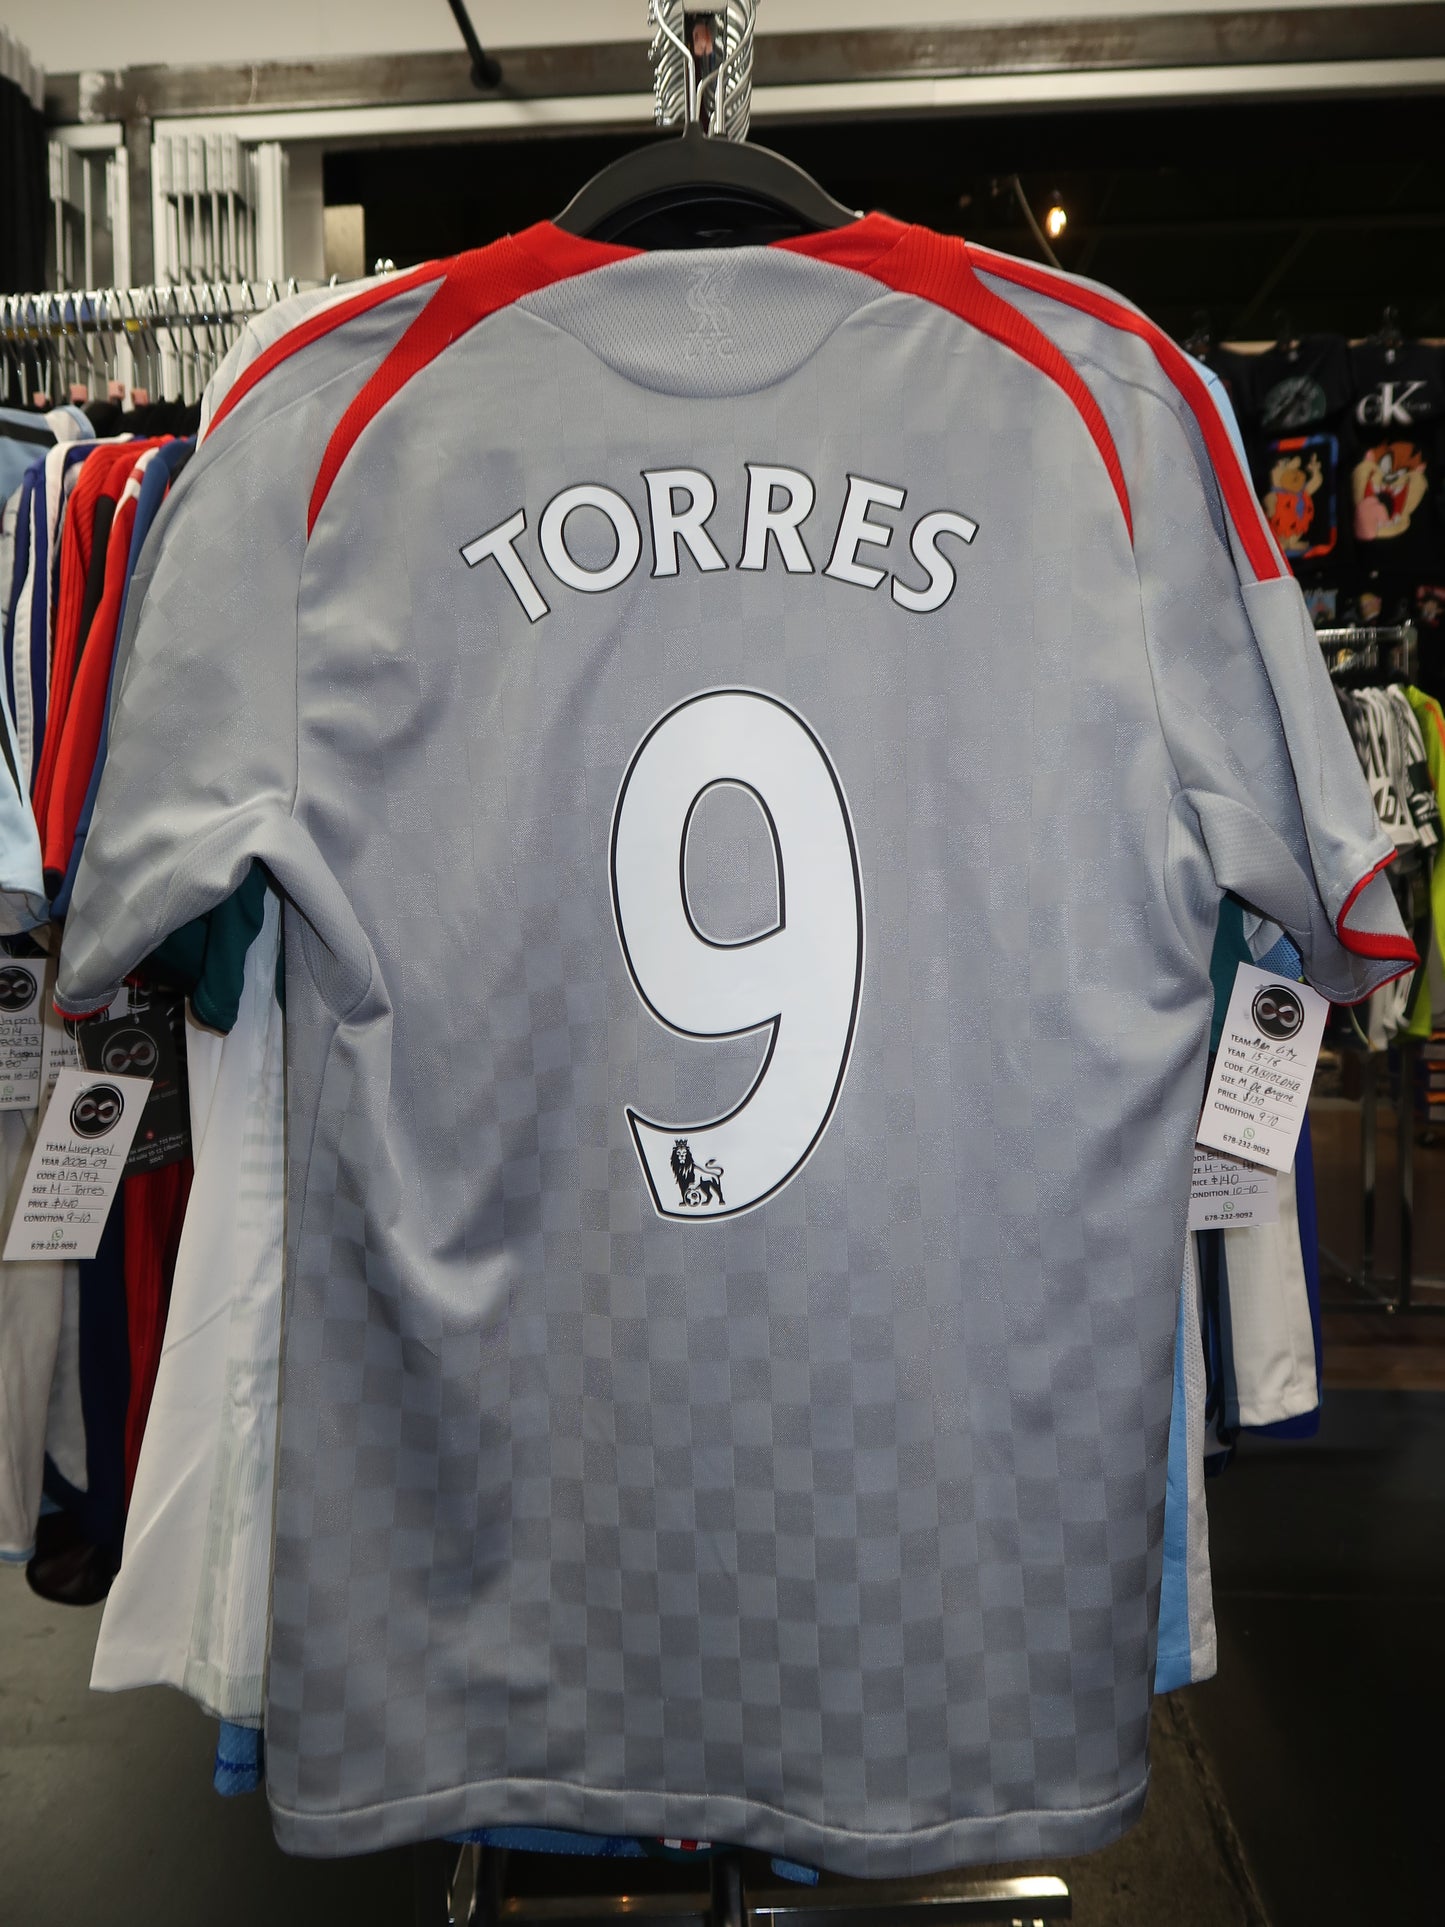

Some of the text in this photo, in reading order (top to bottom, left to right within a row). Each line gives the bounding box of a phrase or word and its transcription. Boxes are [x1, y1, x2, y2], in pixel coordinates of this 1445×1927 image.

[460, 462, 980, 624] TORRES
[608, 684, 866, 1224] 9
[1231, 1034, 1252, 1047] TEAM
[1227, 1047, 1246, 1059] YEAR
[1223, 1061, 1244, 1073] CODE
[1220, 1074, 1236, 1085] SIZE
[1238, 1077, 1248, 1087] M
[1249, 1082, 1262, 1093] De
[1216, 1087, 1265, 1106] PRICE $130
[1213, 1101, 1255, 1121] CONDITION
[46, 1143, 66, 1152] TEAM
[68, 1139, 114, 1158] Liverpool
[1222, 1134, 1271, 1156] 678-232-9092
[41, 1157, 60, 1166] YEAR
[36, 1171, 57, 1180] CODE
[1211, 1173, 1240, 1187] $140
[32, 1186, 47, 1194] SIZE
[71, 1184, 104, 1196] Torres
[1232, 1184, 1259, 1196] 10-10
[28, 1200, 49, 1209] PRICE
[23, 1213, 64, 1223] CONDITION
[1204, 1211, 1254, 1222] 678-232-9092
